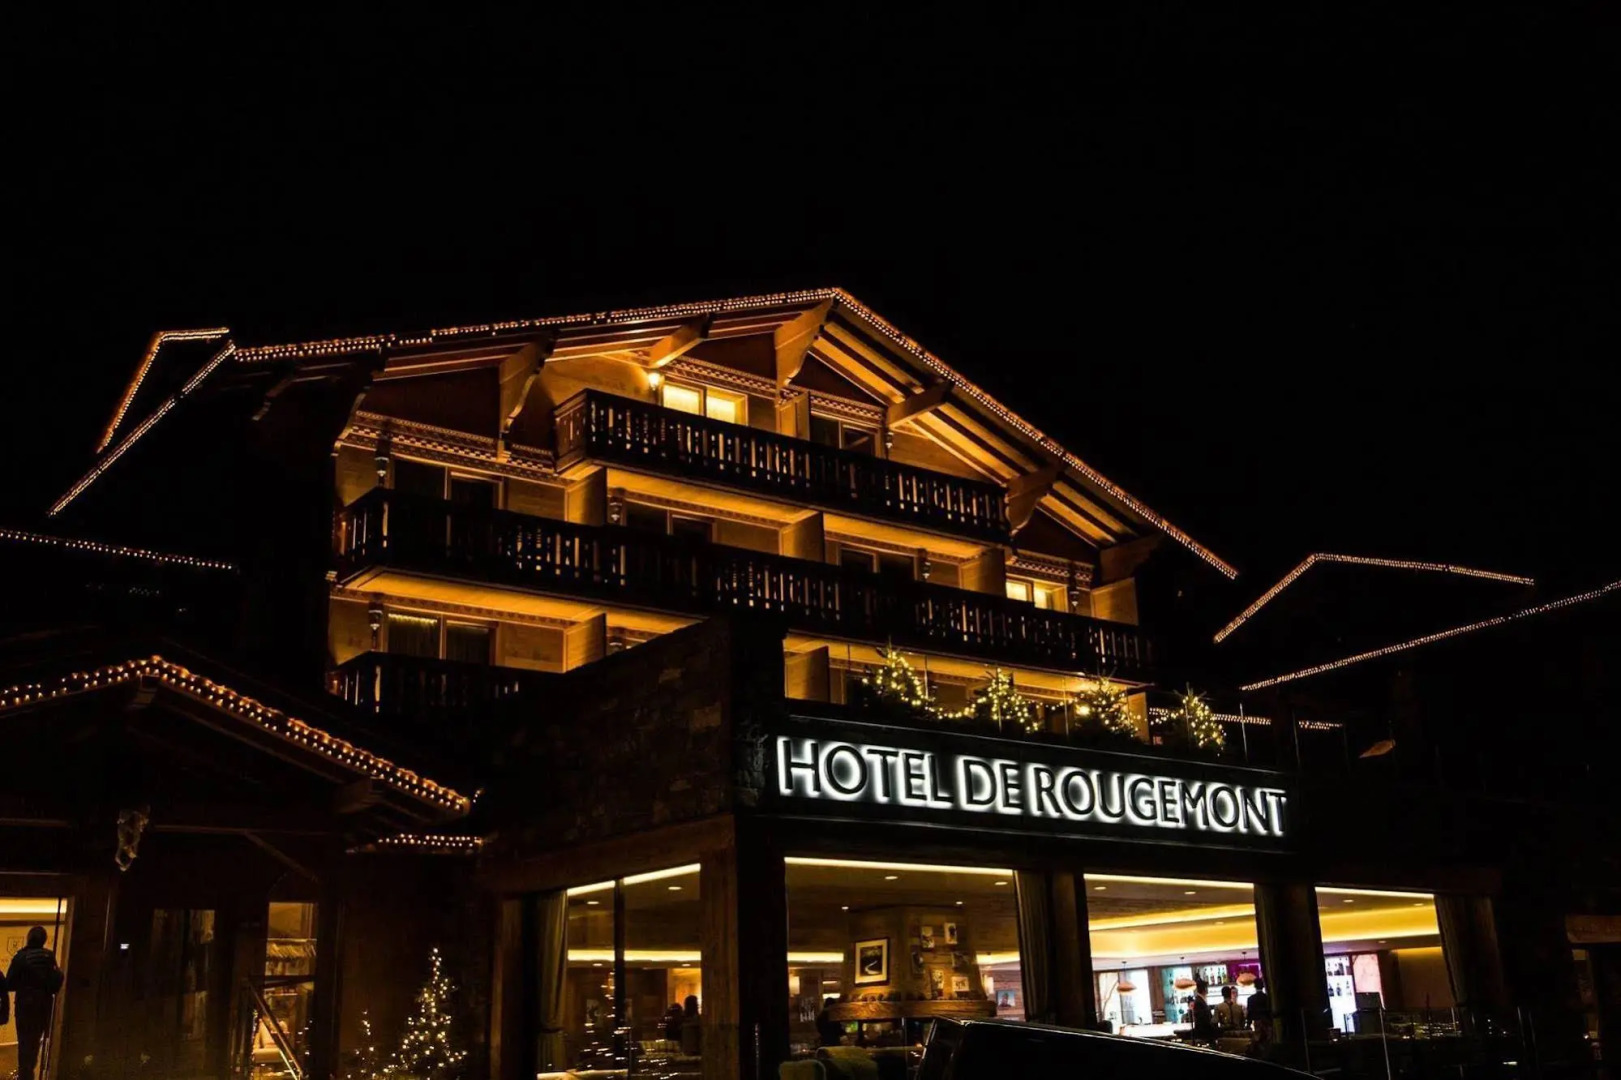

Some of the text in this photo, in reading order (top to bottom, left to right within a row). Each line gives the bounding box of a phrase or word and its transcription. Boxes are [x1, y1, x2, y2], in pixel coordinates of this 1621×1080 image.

[778, 737, 1287, 836] HOTEL DE ROUGEMONT
